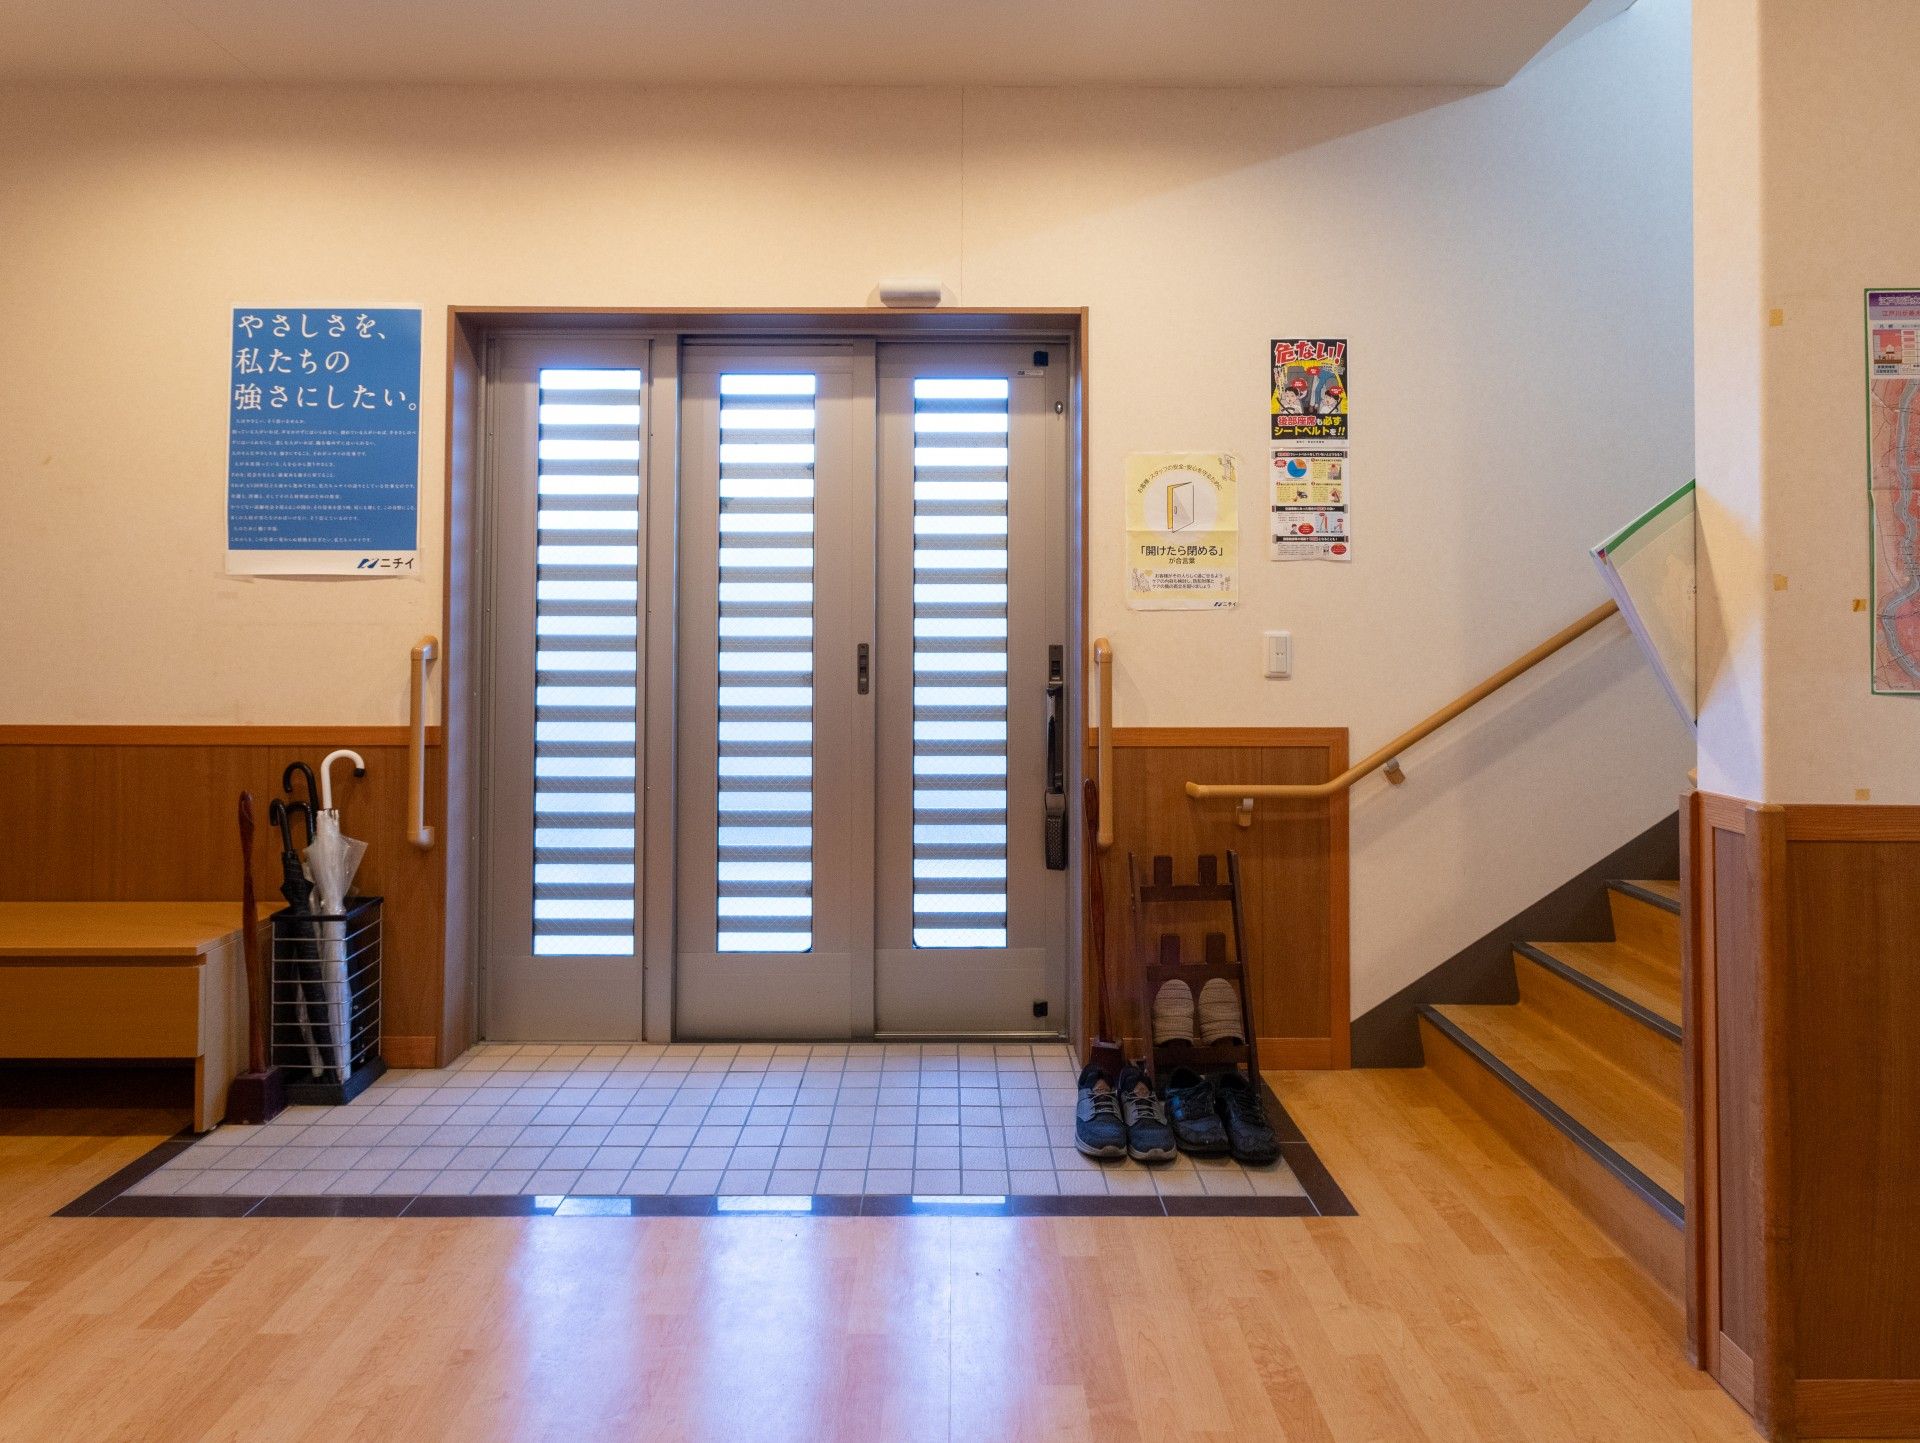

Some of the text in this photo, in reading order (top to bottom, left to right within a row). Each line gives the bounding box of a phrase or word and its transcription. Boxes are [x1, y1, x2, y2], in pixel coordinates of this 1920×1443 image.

[237, 313, 386, 340] やさしさを、
[235, 347, 350, 375] 私たちの
[234, 382, 417, 411] 強さにしたい。
[380, 558, 415, 569] ニチイ
[1168, 557, 1196, 565] が合言葉
